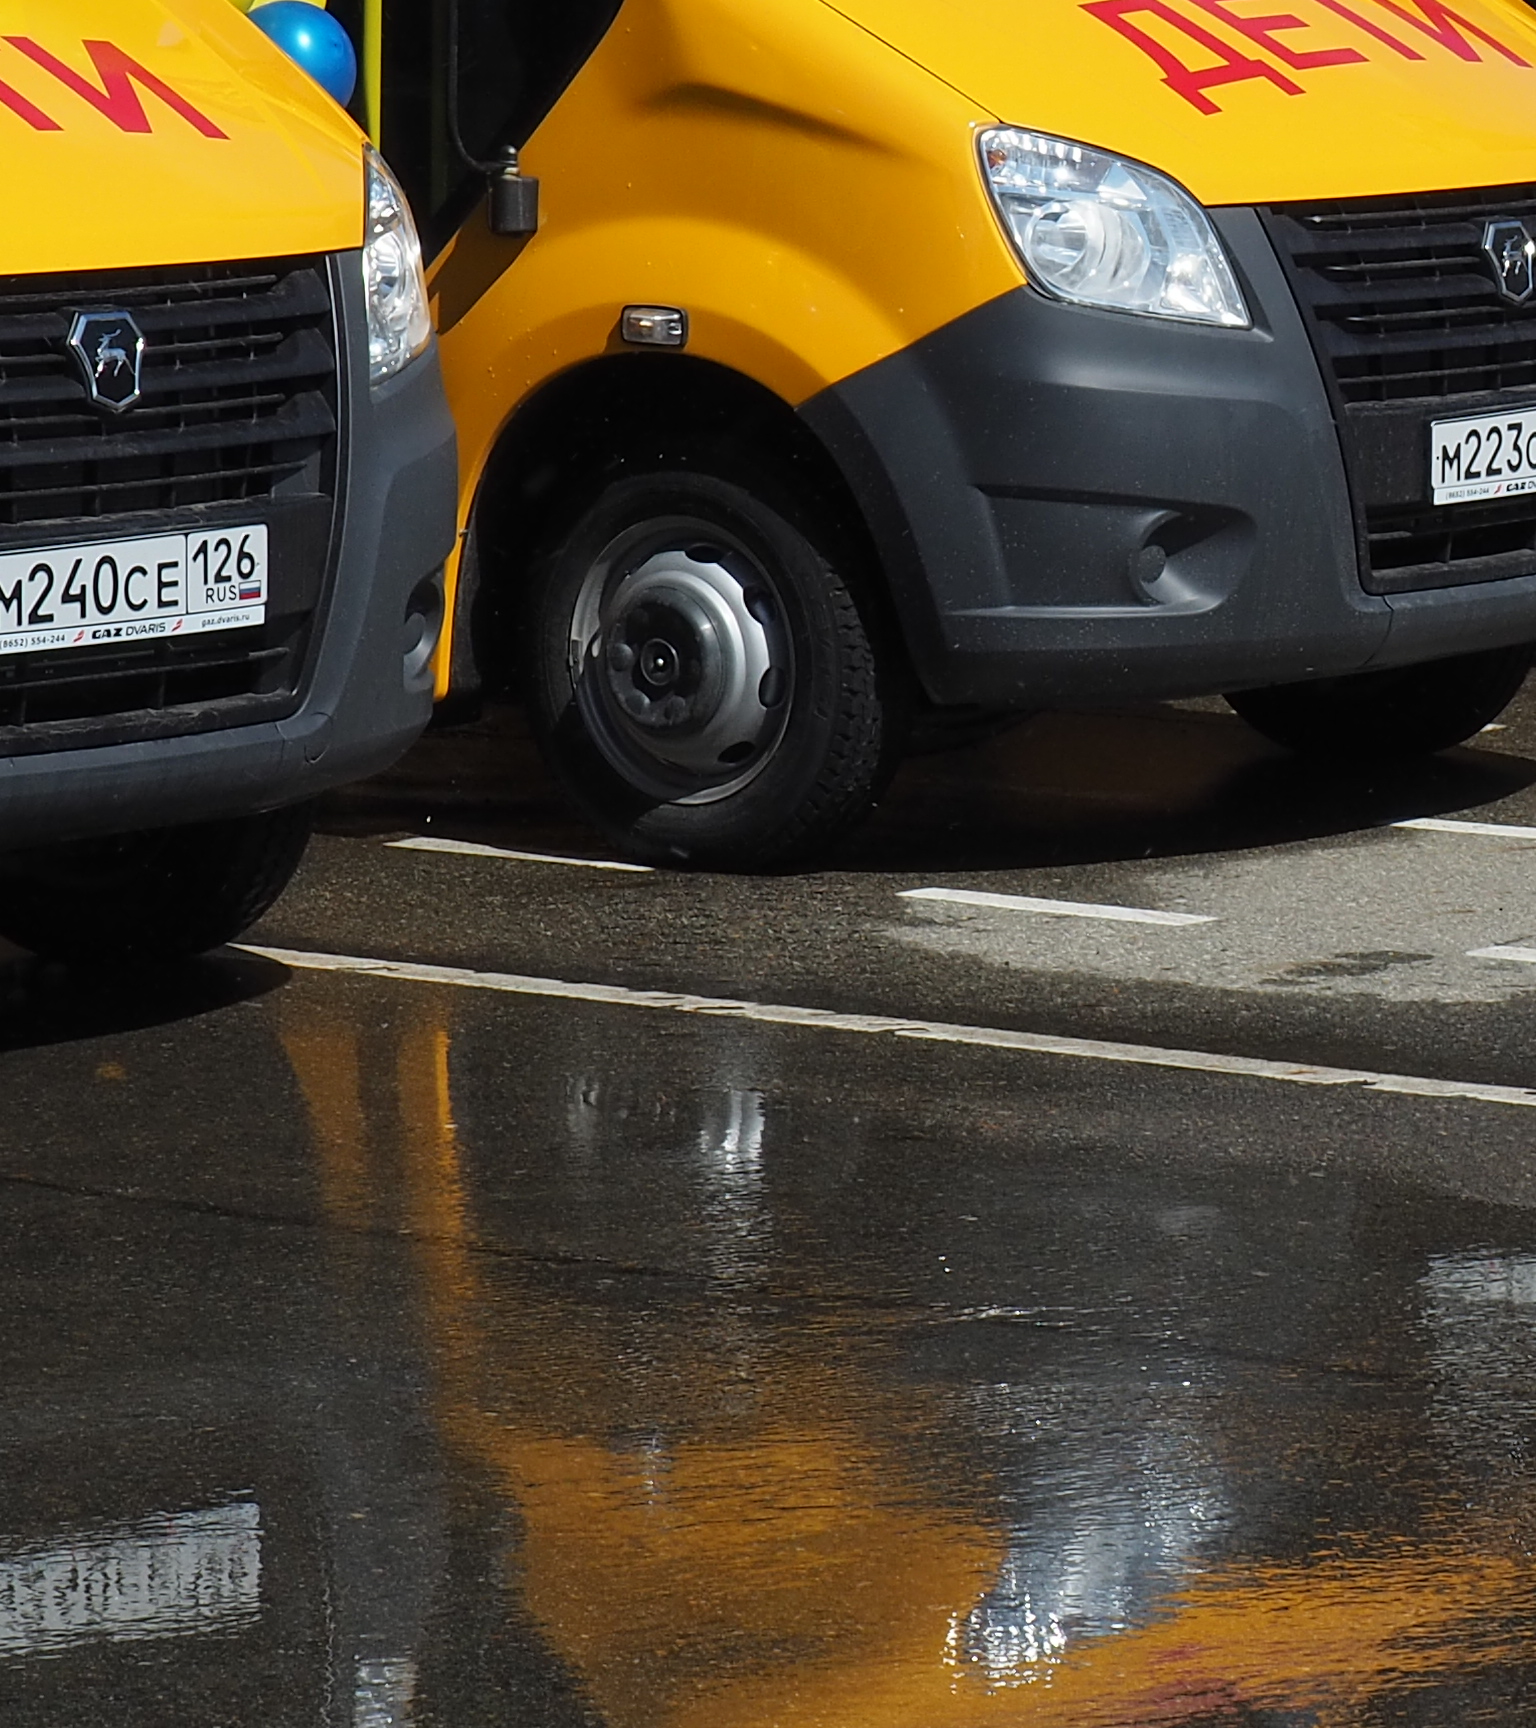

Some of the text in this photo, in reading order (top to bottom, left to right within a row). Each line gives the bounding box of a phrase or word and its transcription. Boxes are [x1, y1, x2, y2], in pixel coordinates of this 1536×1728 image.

[191, 533, 256, 586] 126
[205, 584, 237, 603] RUS
[30, 632, 66, 646] 554-244
[91, 627, 124, 641] GAZ
[125, 622, 167, 638] DVARIS
